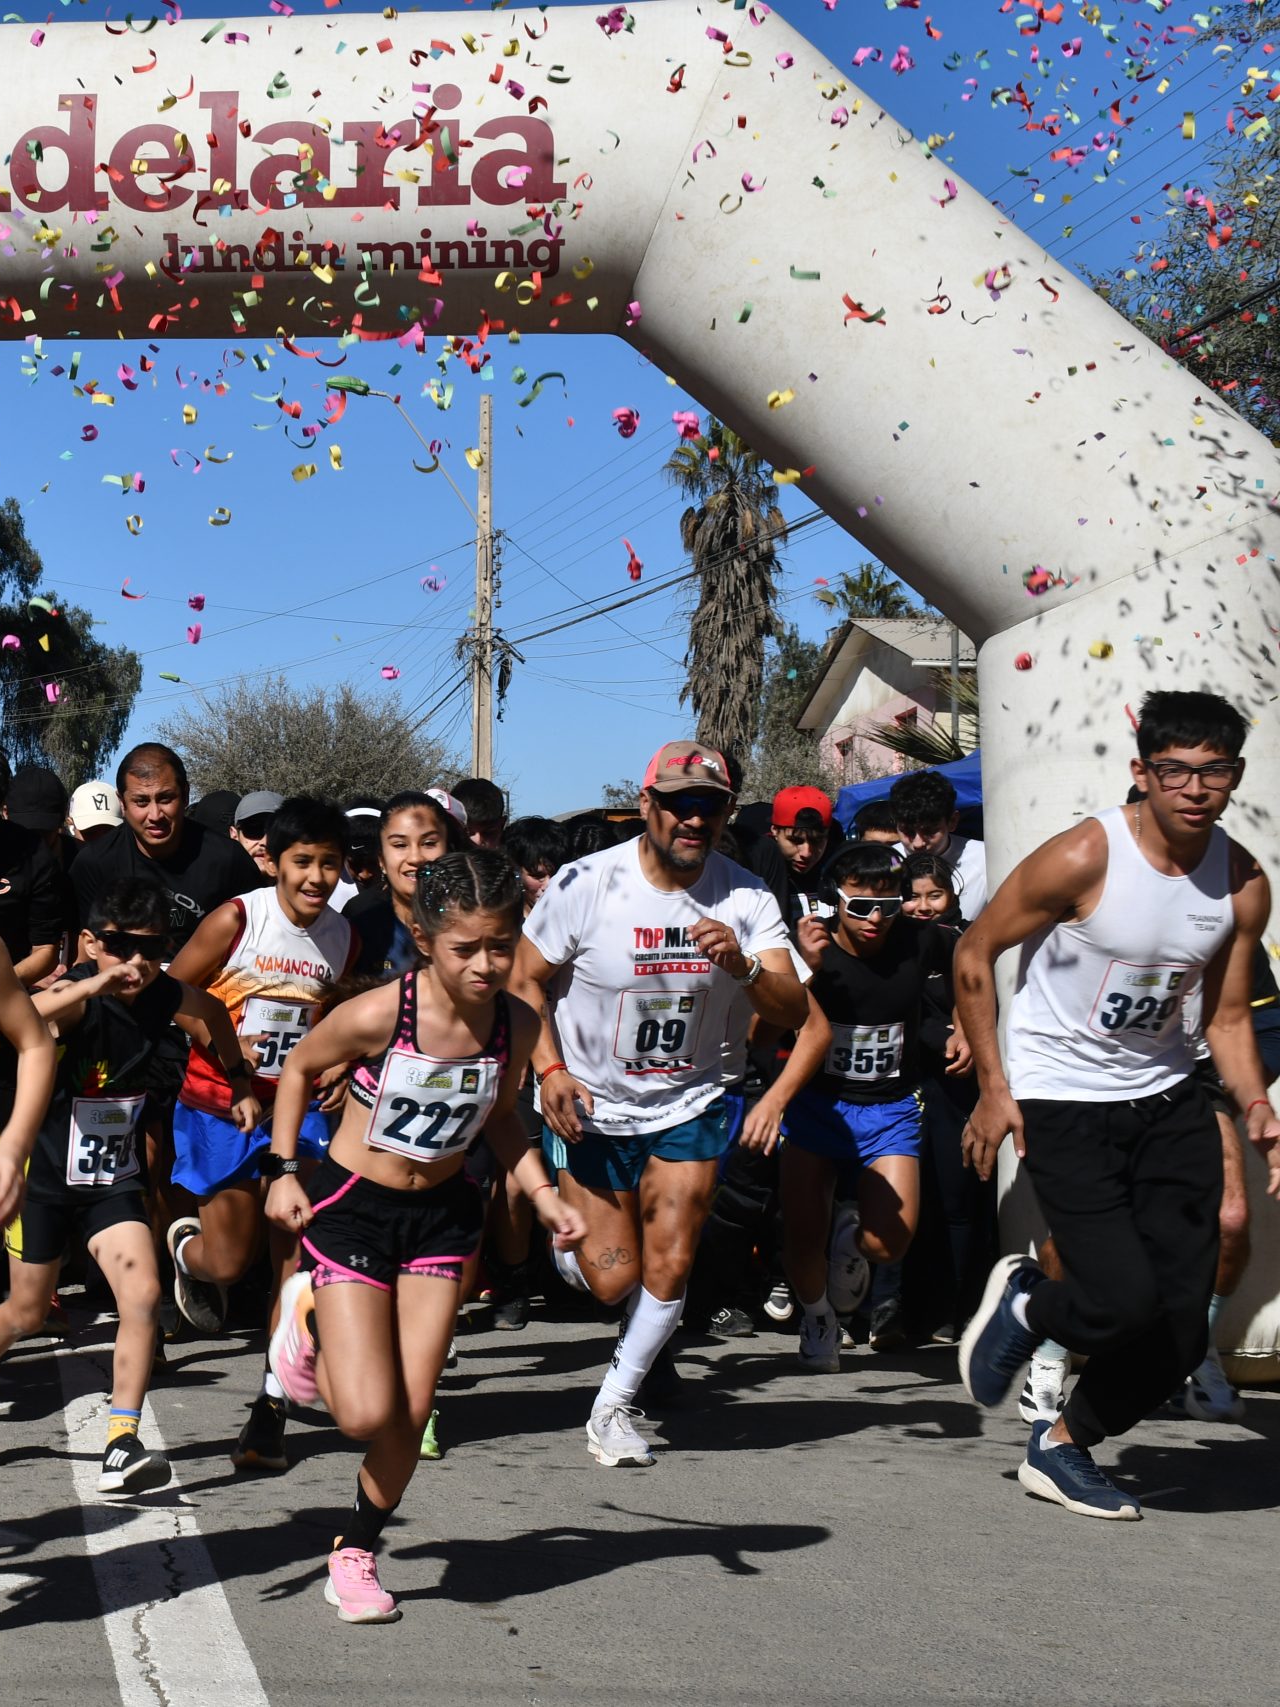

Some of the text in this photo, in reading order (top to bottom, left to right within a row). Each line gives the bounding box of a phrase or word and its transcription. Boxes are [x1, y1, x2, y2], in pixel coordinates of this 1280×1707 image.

[162, 227, 566, 278] lundin mining
[634, 927, 699, 948] TOPMA
[1194, 923, 1217, 931] TEAM
[636, 963, 709, 974] TRIATLON
[635, 1019, 686, 1053] 09
[832, 1046, 894, 1074] 355
[382, 1097, 479, 1149] 222
